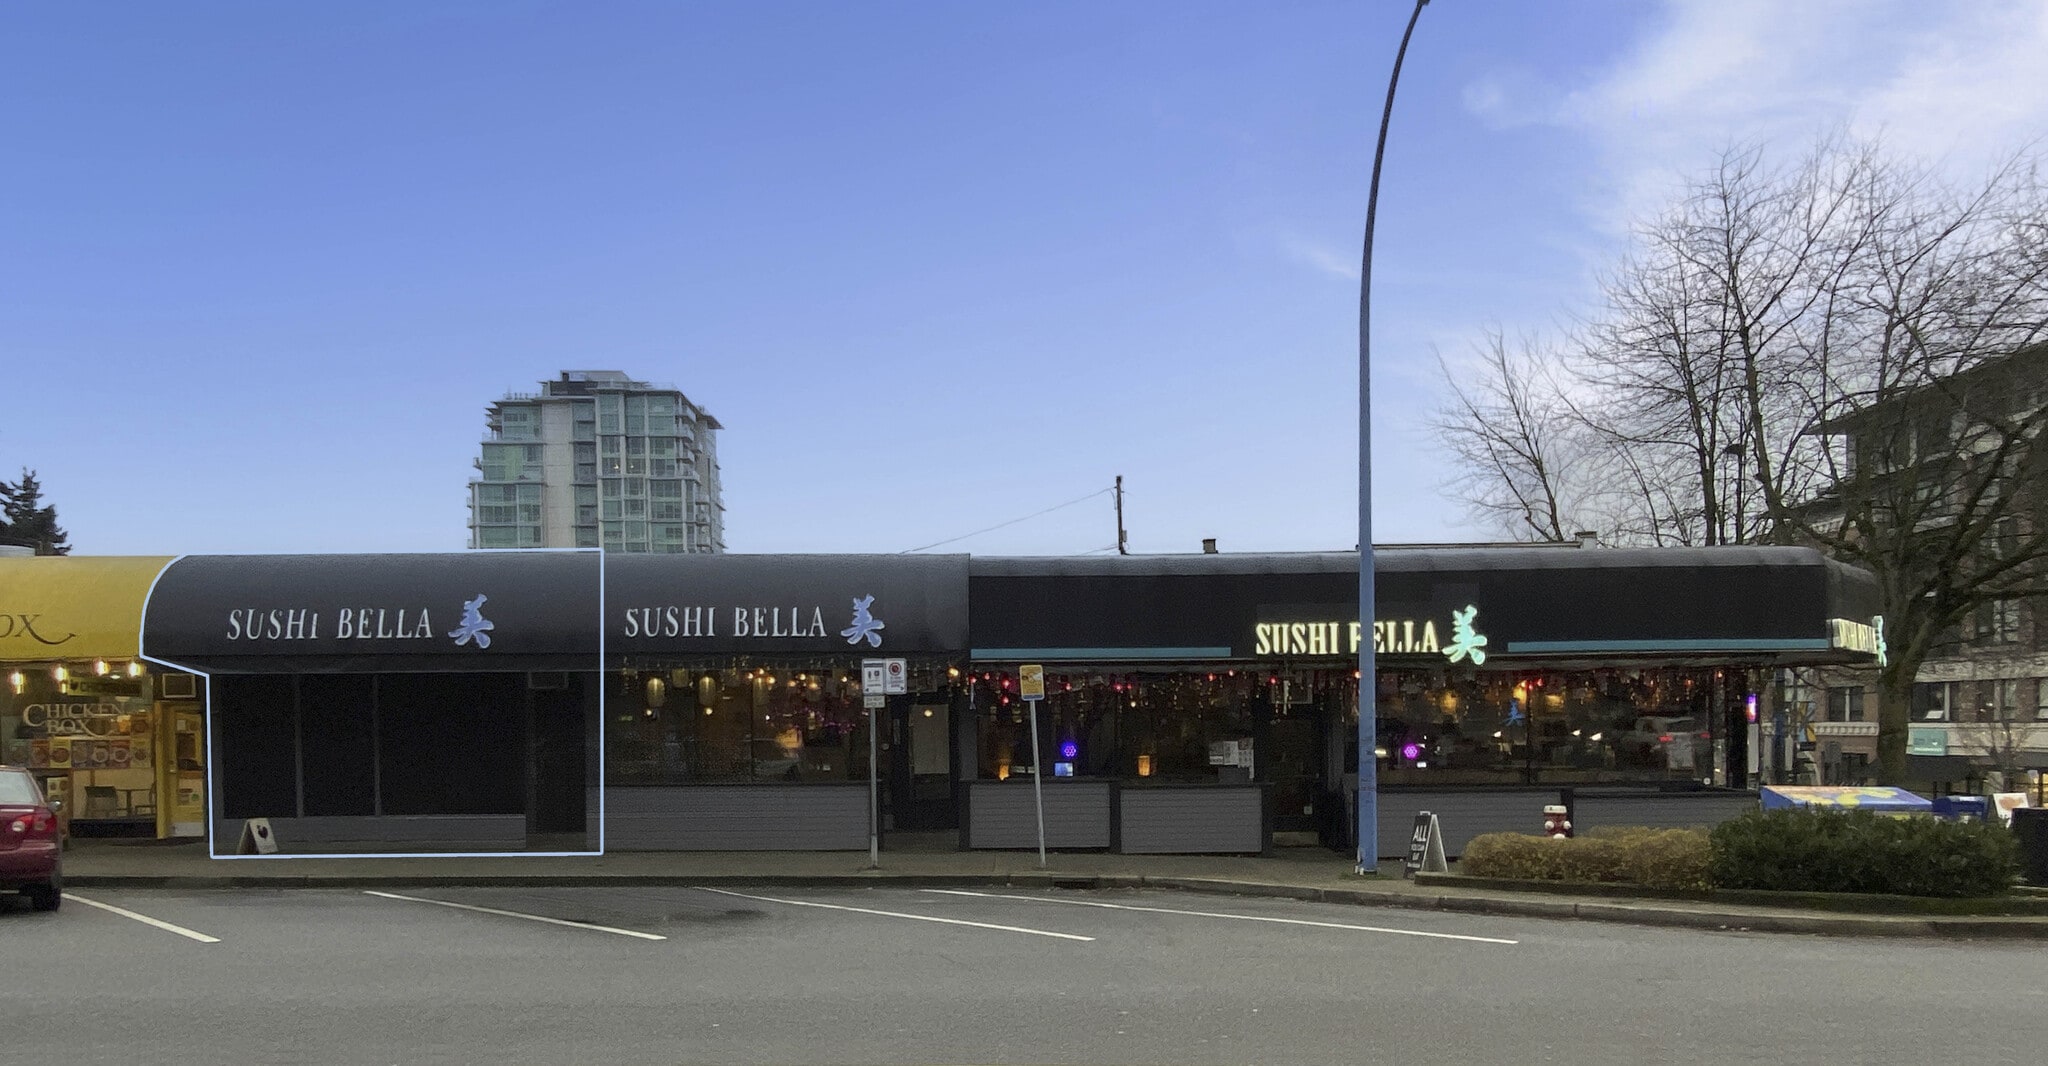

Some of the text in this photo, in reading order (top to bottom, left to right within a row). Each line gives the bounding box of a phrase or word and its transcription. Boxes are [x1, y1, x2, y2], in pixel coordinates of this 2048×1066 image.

[336, 608, 433, 639] BELLA
[448, 593, 495, 649] 美
[624, 605, 828, 637] SUSHI BELLA
[840, 594, 886, 648] 美
[1441, 604, 1488, 666] 美
[1255, 622, 1340, 655] SUSHI
[23, 703, 125, 727] CHICKEN
[46, 718, 116, 738] BOX
[1411, 824, 1428, 842] ALL
